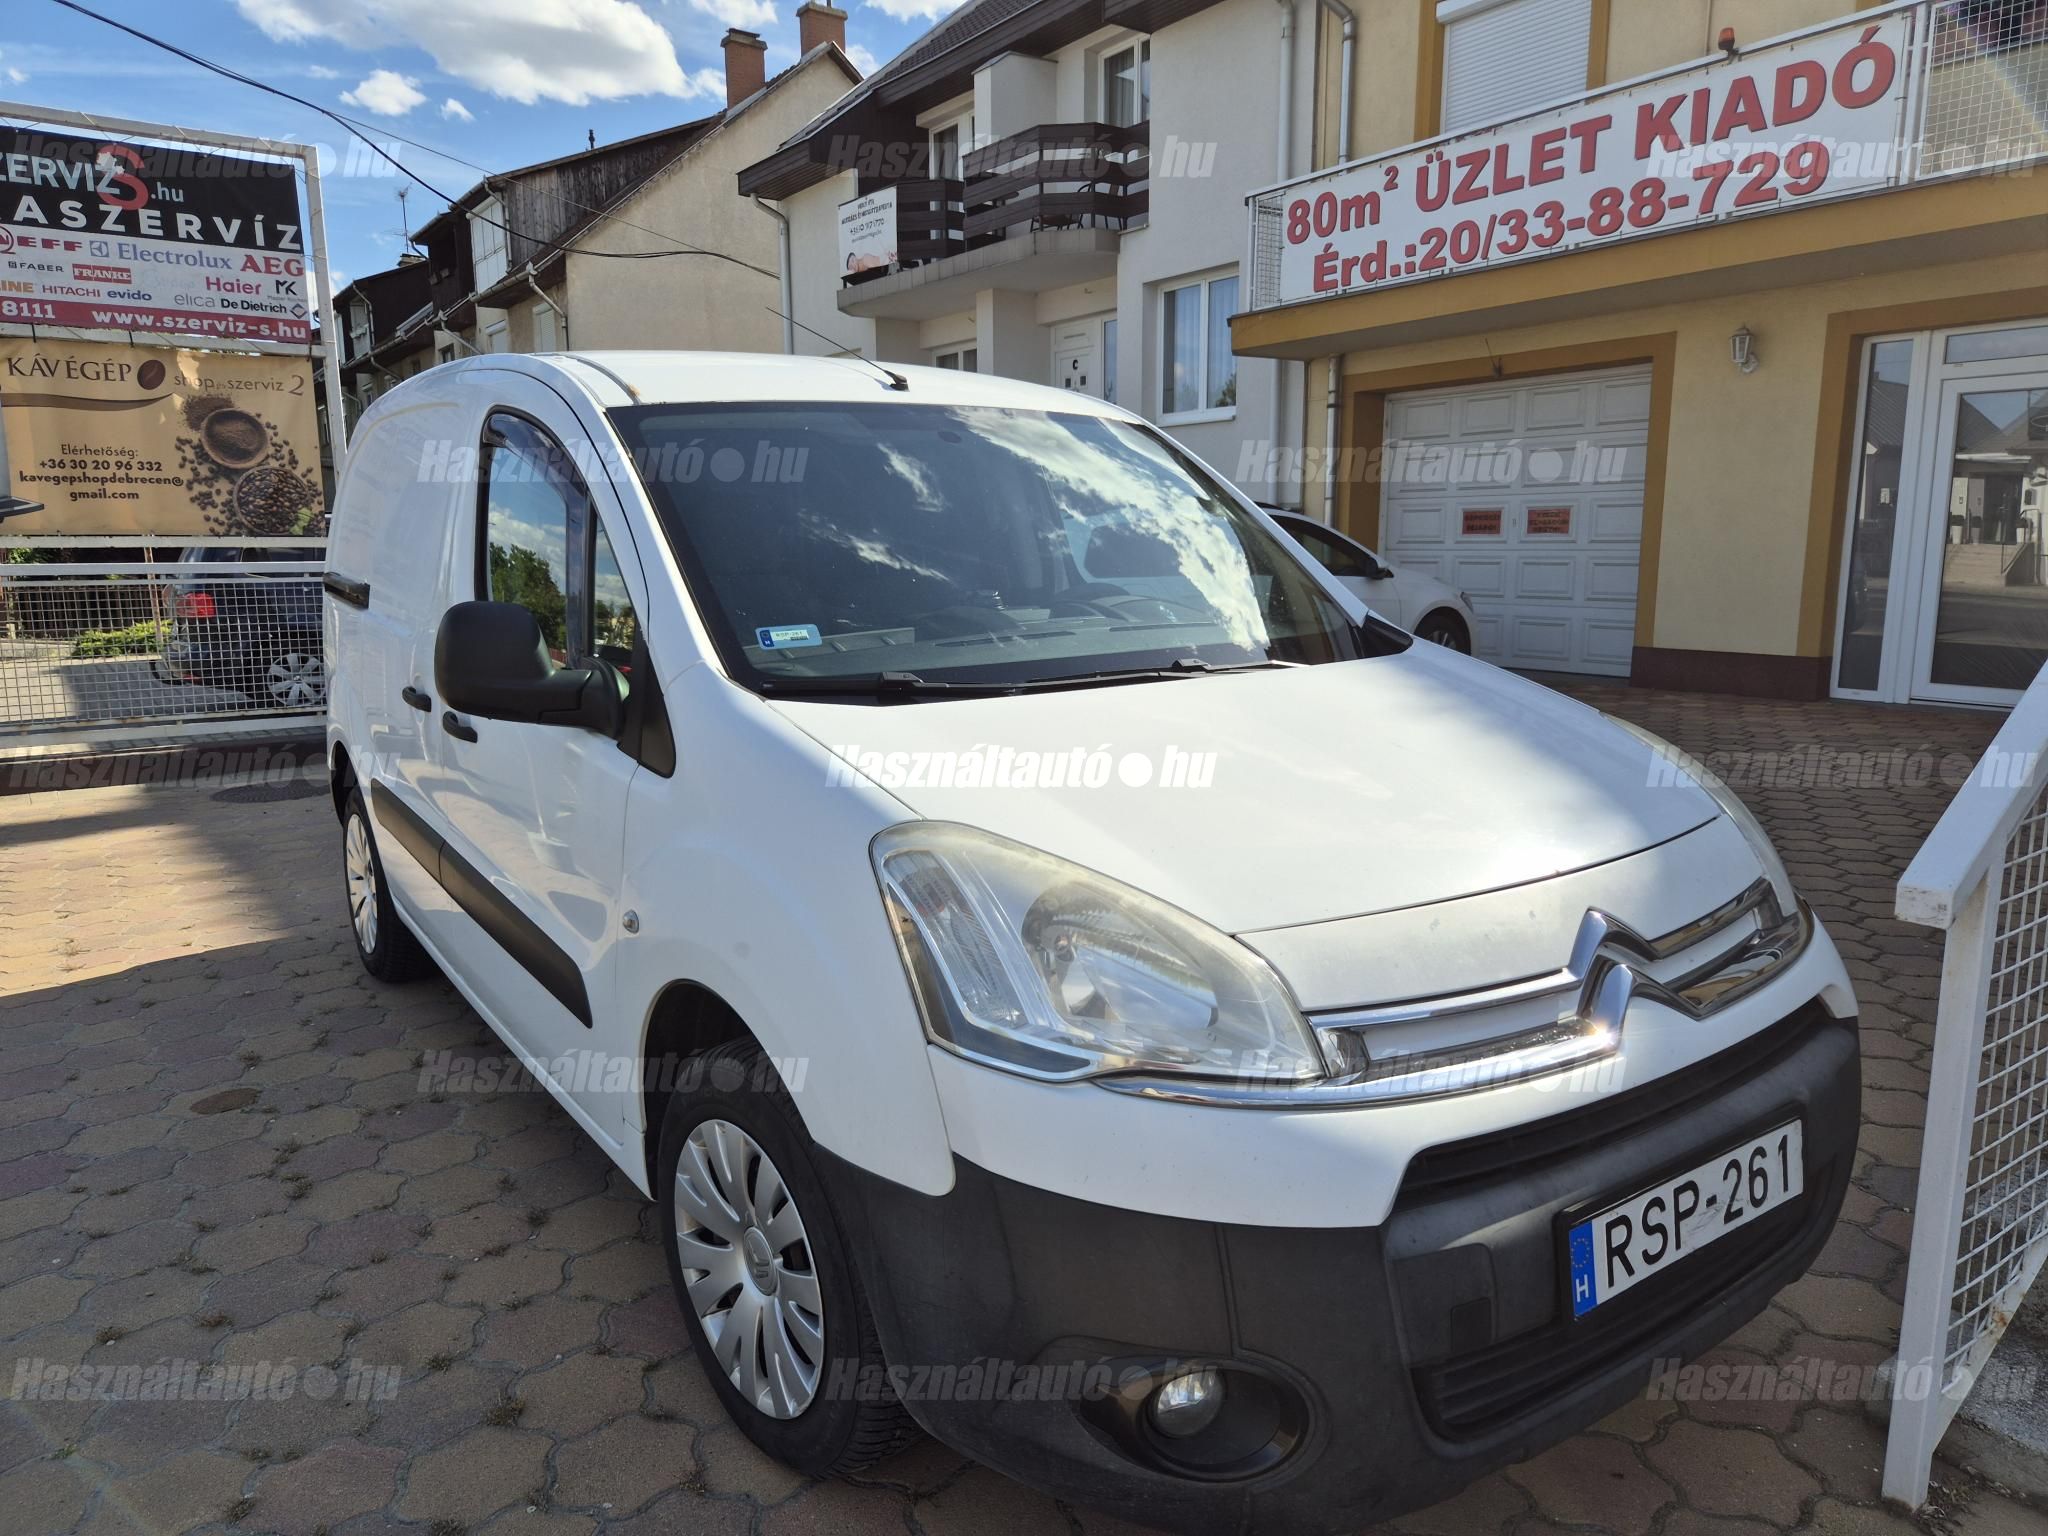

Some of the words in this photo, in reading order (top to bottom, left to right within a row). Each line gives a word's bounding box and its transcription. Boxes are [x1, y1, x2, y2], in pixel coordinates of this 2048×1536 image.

[1415, 115, 1612, 213] ÜZLET
[1634, 25, 1896, 160] KIADÓ
[0, 152, 120, 194] ERVIZ
[0, 195, 300, 250] ASZERVÍZ
[1313, 141, 1830, 292] Érd.:20/33-88-729
[118, 243, 232, 269] Electrolux
[240, 254, 304, 277] AEG
[20, 262, 64, 272] FABER
[74, 268, 131, 280] FRANKE
[205, 276, 262, 294] Haier
[0, 281, 34, 293] INE
[42, 284, 101, 297] HITACHI
[107, 289, 152, 301] evido
[174, 293, 215, 308] elica
[221, 298, 239, 309] De
[241, 300, 287, 314] Dietrich
[2, 300, 56, 319] 8111
[92, 311, 306, 339] www.szerviz-s.hu
[7, 353, 132, 383] KÁVÉGÉP
[227, 377, 284, 391] szerviz
[288, 374, 305, 396] 2
[39, 458, 66, 469] +36
[70, 459, 88, 470] 30
[92, 460, 111, 470] 20
[115, 460, 133, 471] 96
[137, 461, 163, 472] 332
[61, 443, 139, 460] Elérhetőség:
[19, 470, 184, 486] kavegepshopdebrecen@
[70, 488, 139, 501] gmail.com
[1576, 1274, 1590, 1302] H
[1605, 1134, 1789, 1289] RSP-261
